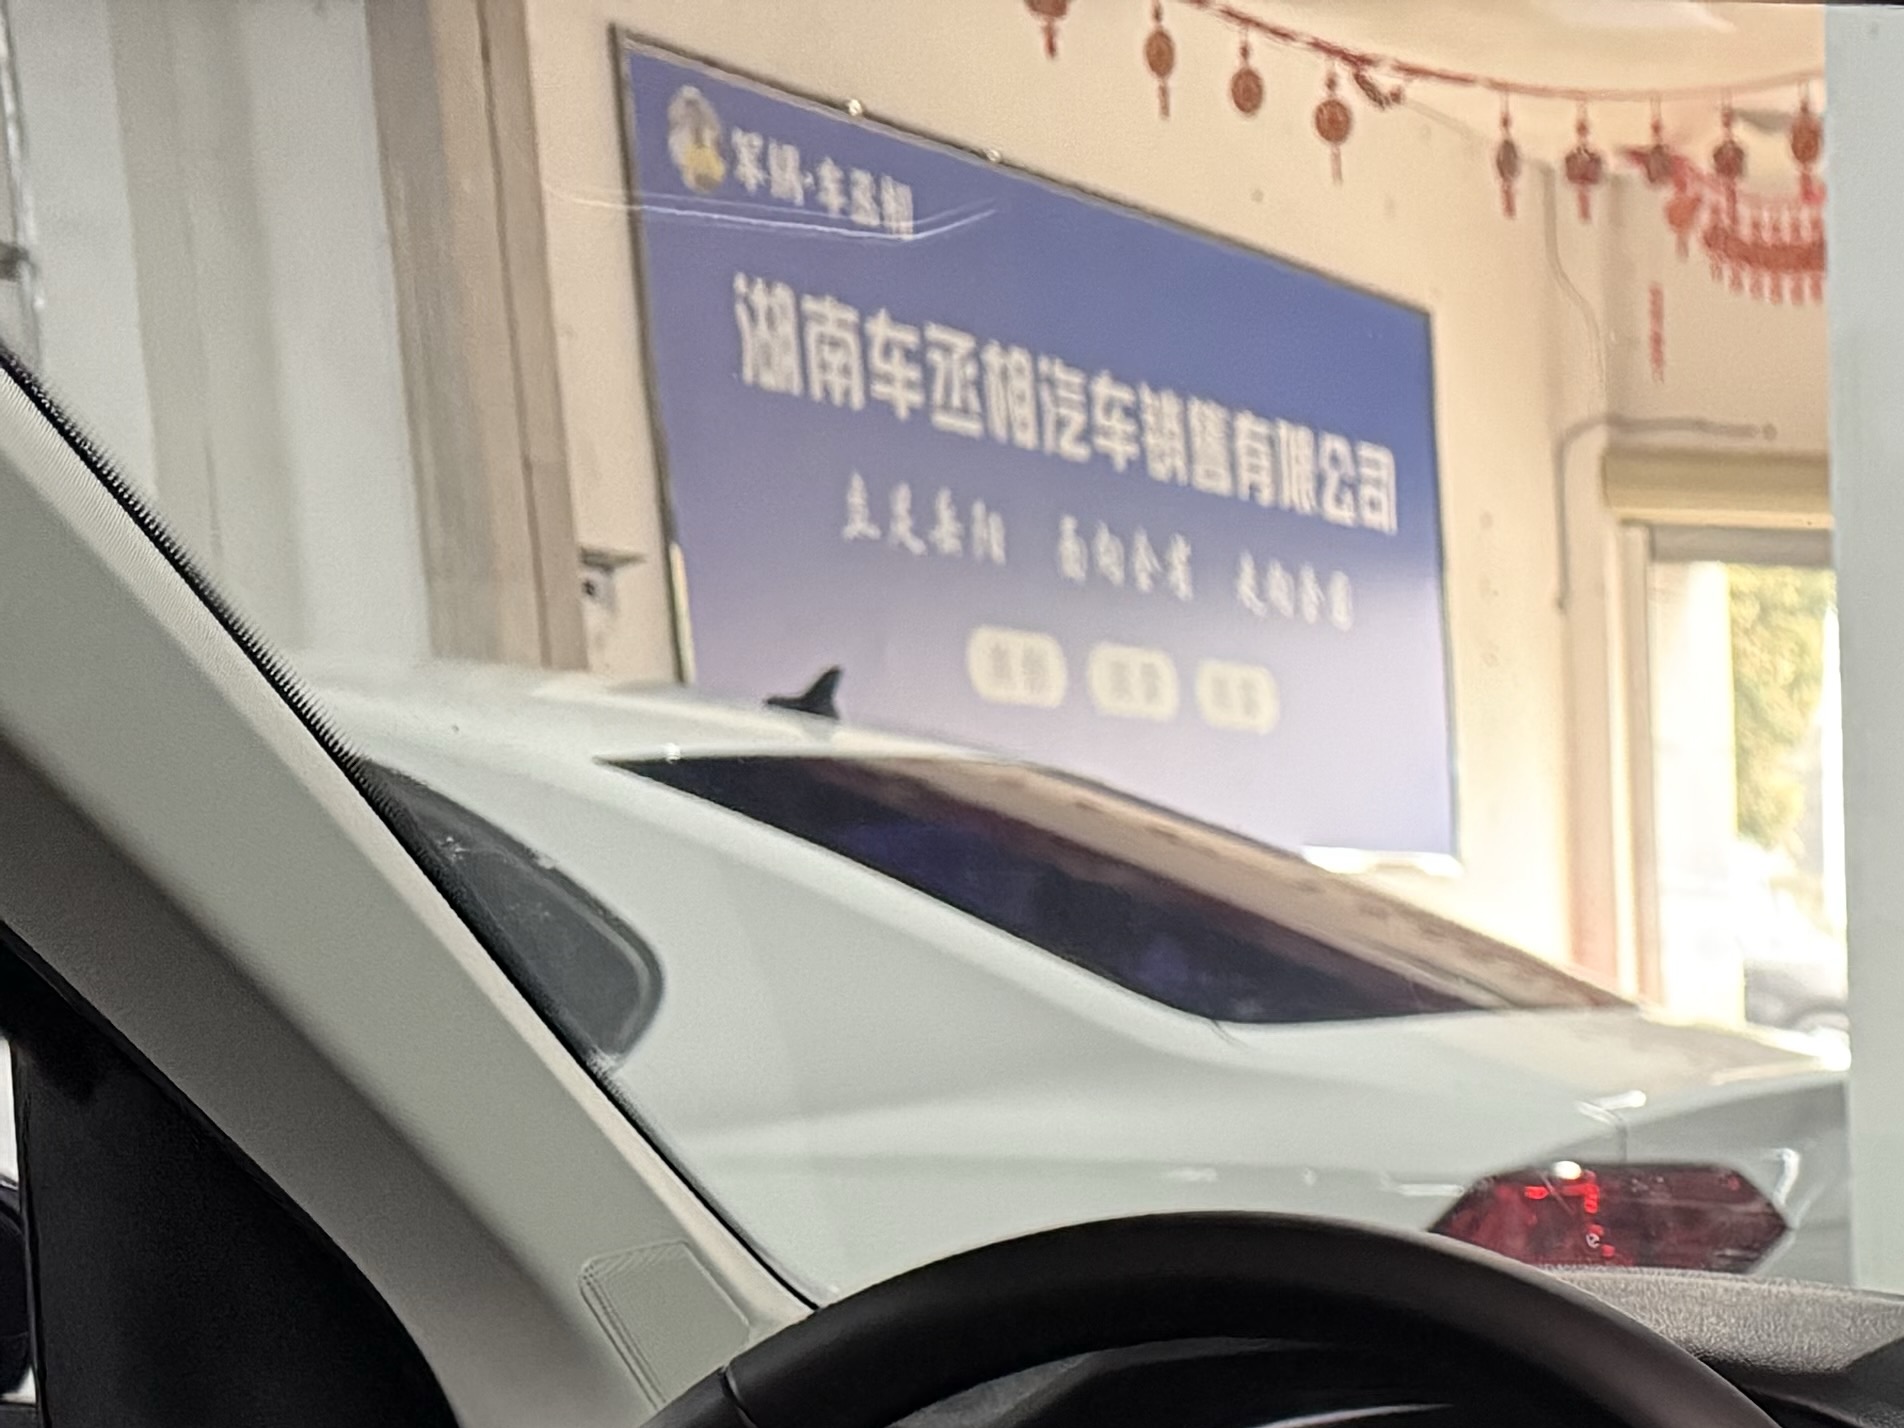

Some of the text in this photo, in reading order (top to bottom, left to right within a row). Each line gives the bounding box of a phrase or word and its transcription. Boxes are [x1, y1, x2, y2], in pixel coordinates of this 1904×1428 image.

[734, 271, 1397, 537] 湖南车丞相汽车销售有限公司
